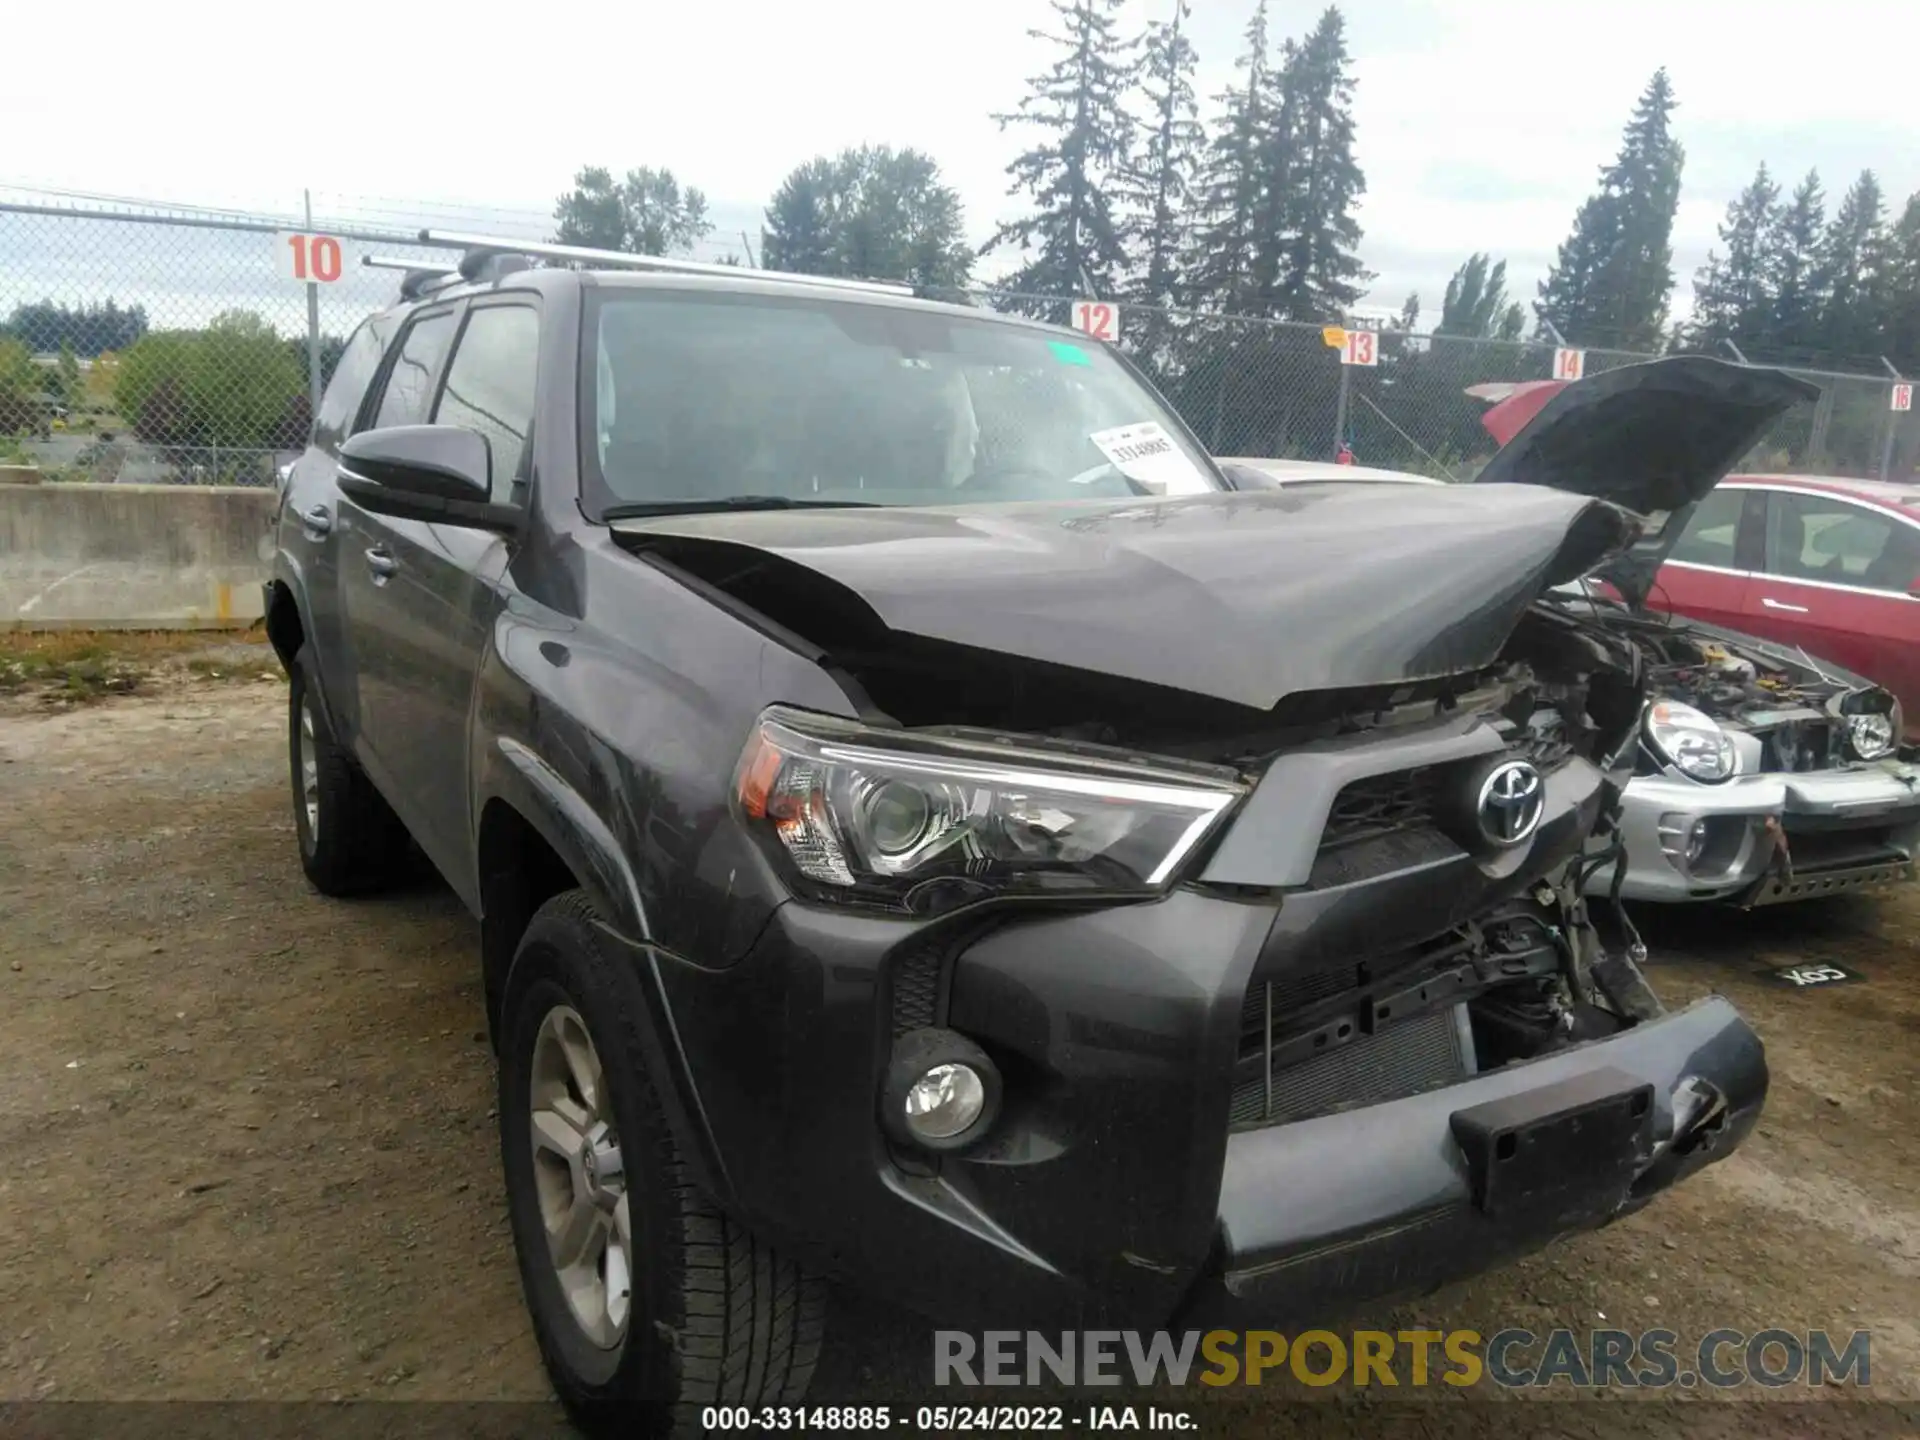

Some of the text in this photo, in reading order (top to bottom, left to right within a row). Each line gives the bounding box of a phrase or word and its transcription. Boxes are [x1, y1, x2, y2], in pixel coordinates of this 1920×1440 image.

[288, 235, 342, 281] 10
[1080, 303, 1111, 339] 12
[1347, 331, 1373, 364] 13
[1559, 349, 1579, 379] 14
[1895, 385, 1909, 409] 16
